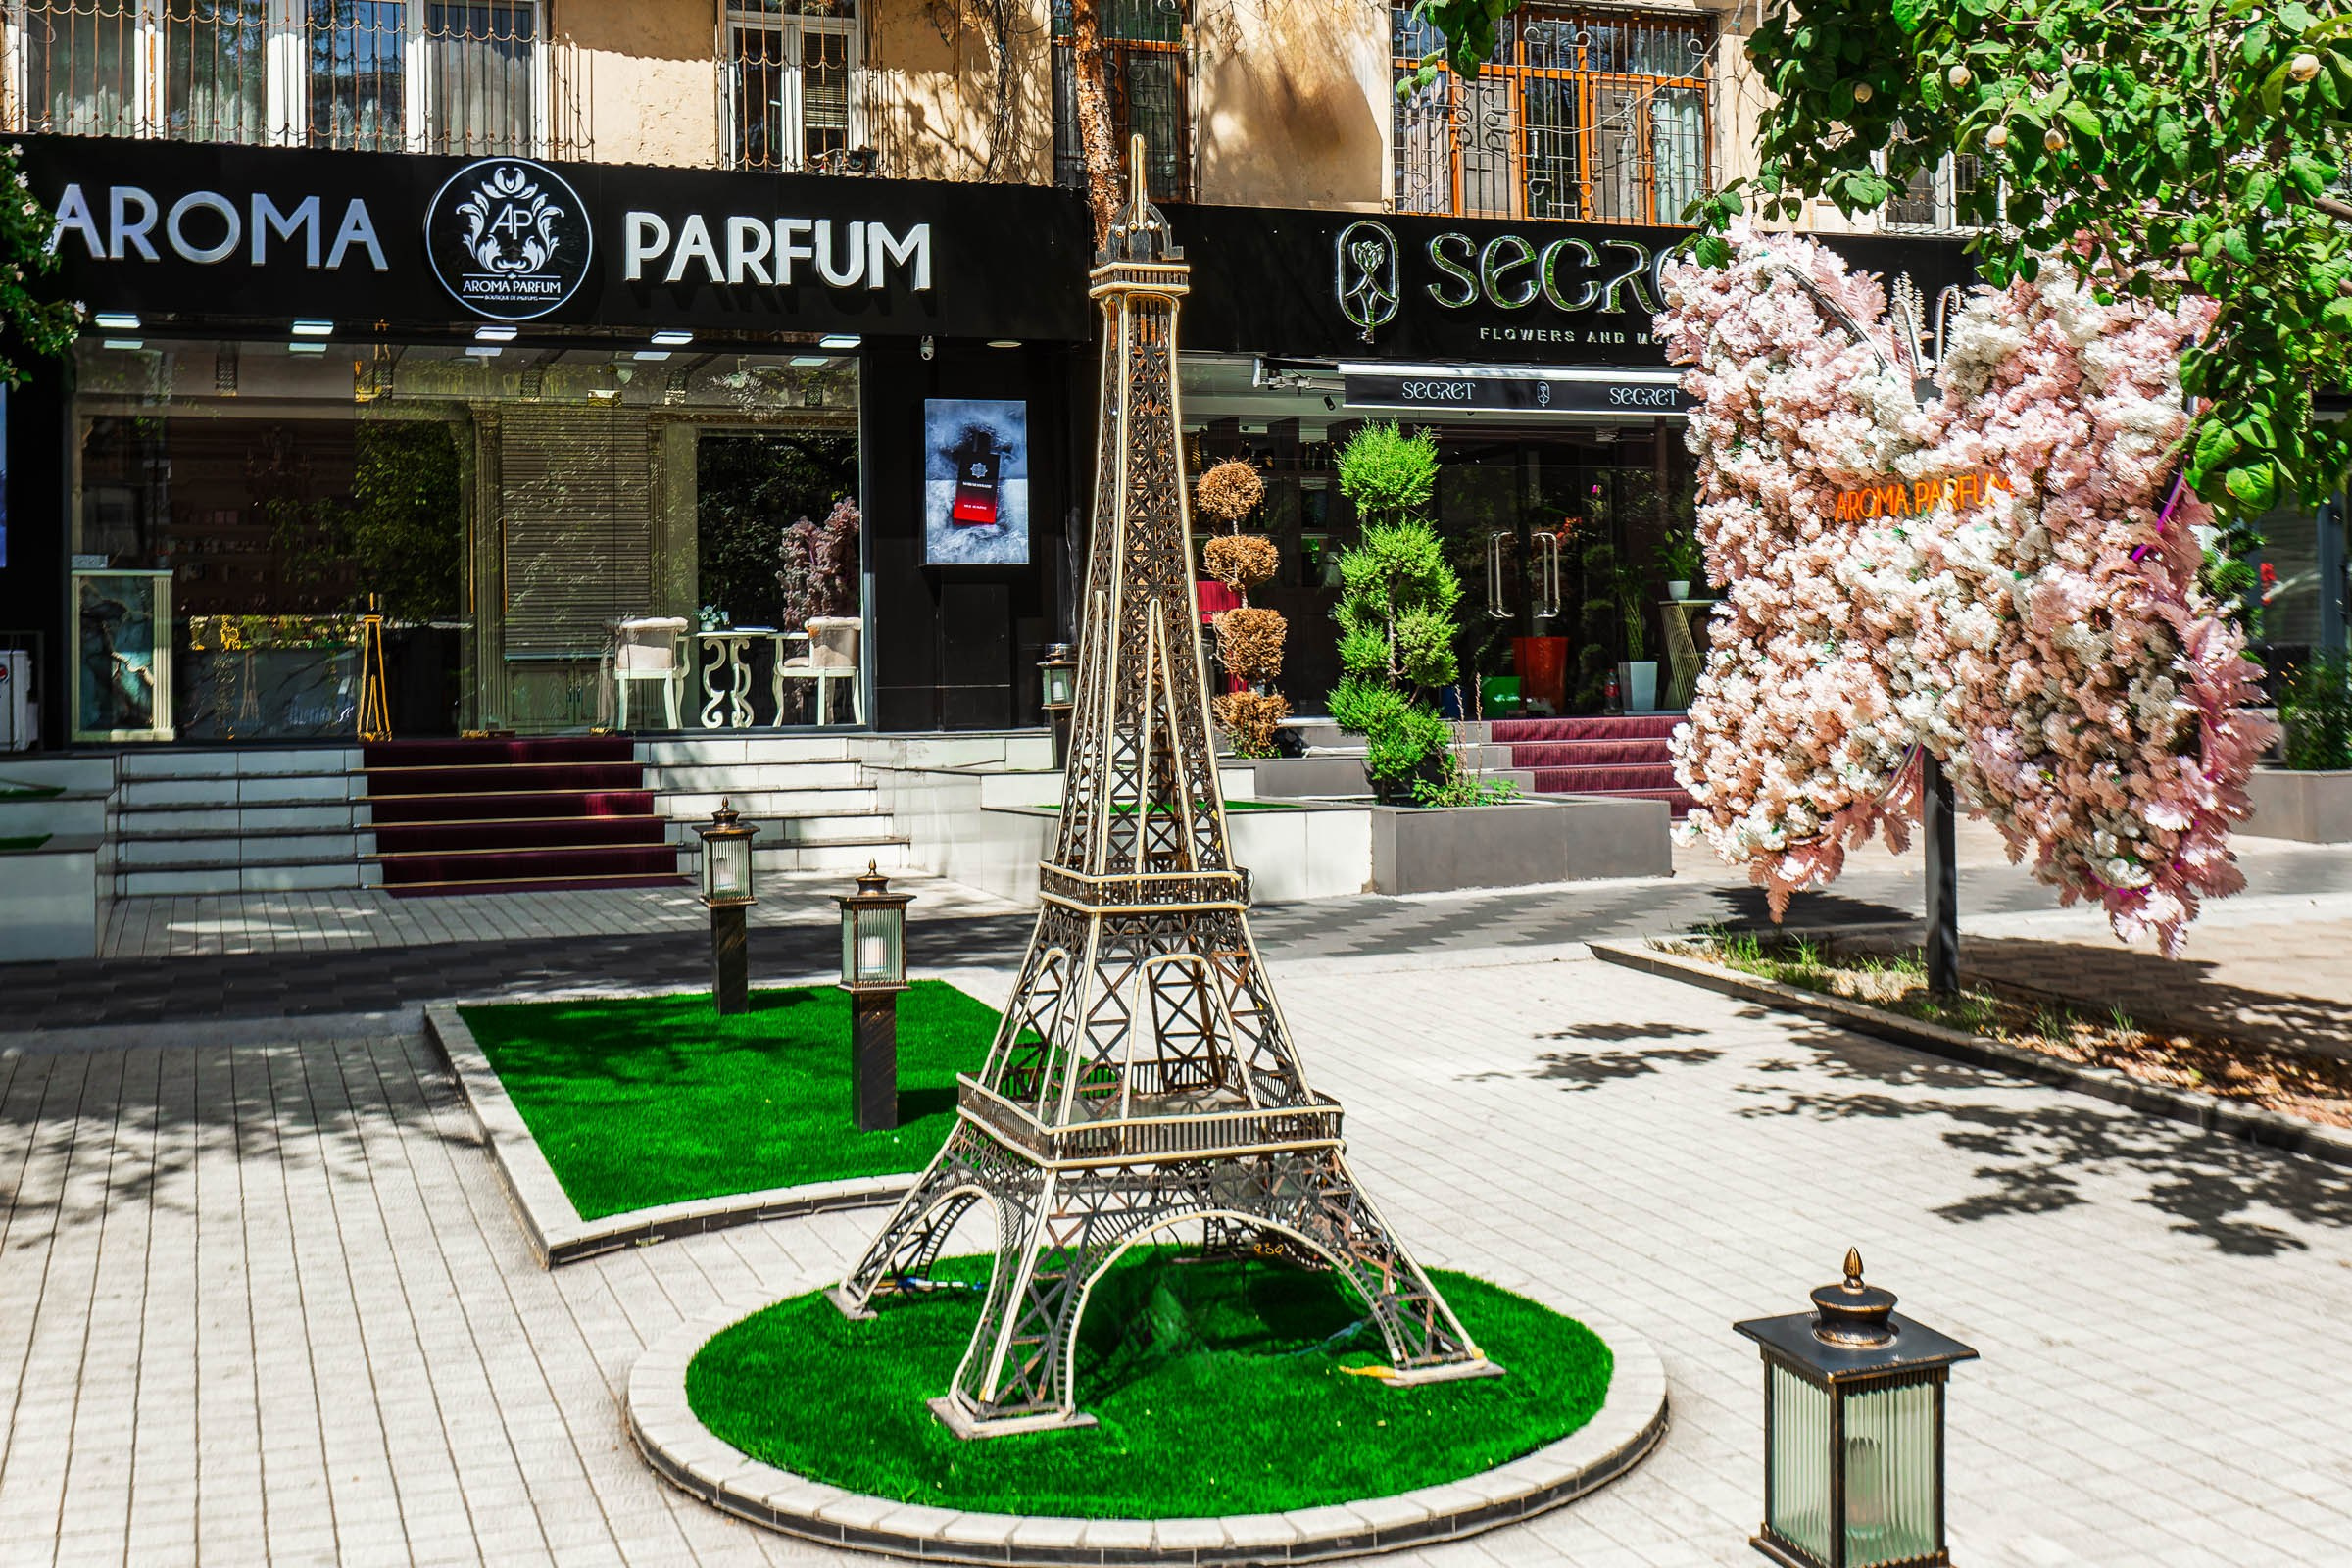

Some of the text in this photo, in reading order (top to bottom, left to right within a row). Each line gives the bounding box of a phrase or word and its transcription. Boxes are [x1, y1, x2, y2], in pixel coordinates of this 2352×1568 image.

[42, 183, 931, 292] AROMA PARFUM
[489, 203, 533, 241] AP
[463, 280, 561, 294] AROMA PARFUM
[1427, 232, 1676, 315] SECR
[1480, 327, 1671, 344] FLOWERS AND MO
[1835, 483, 1911, 523] AROMA
